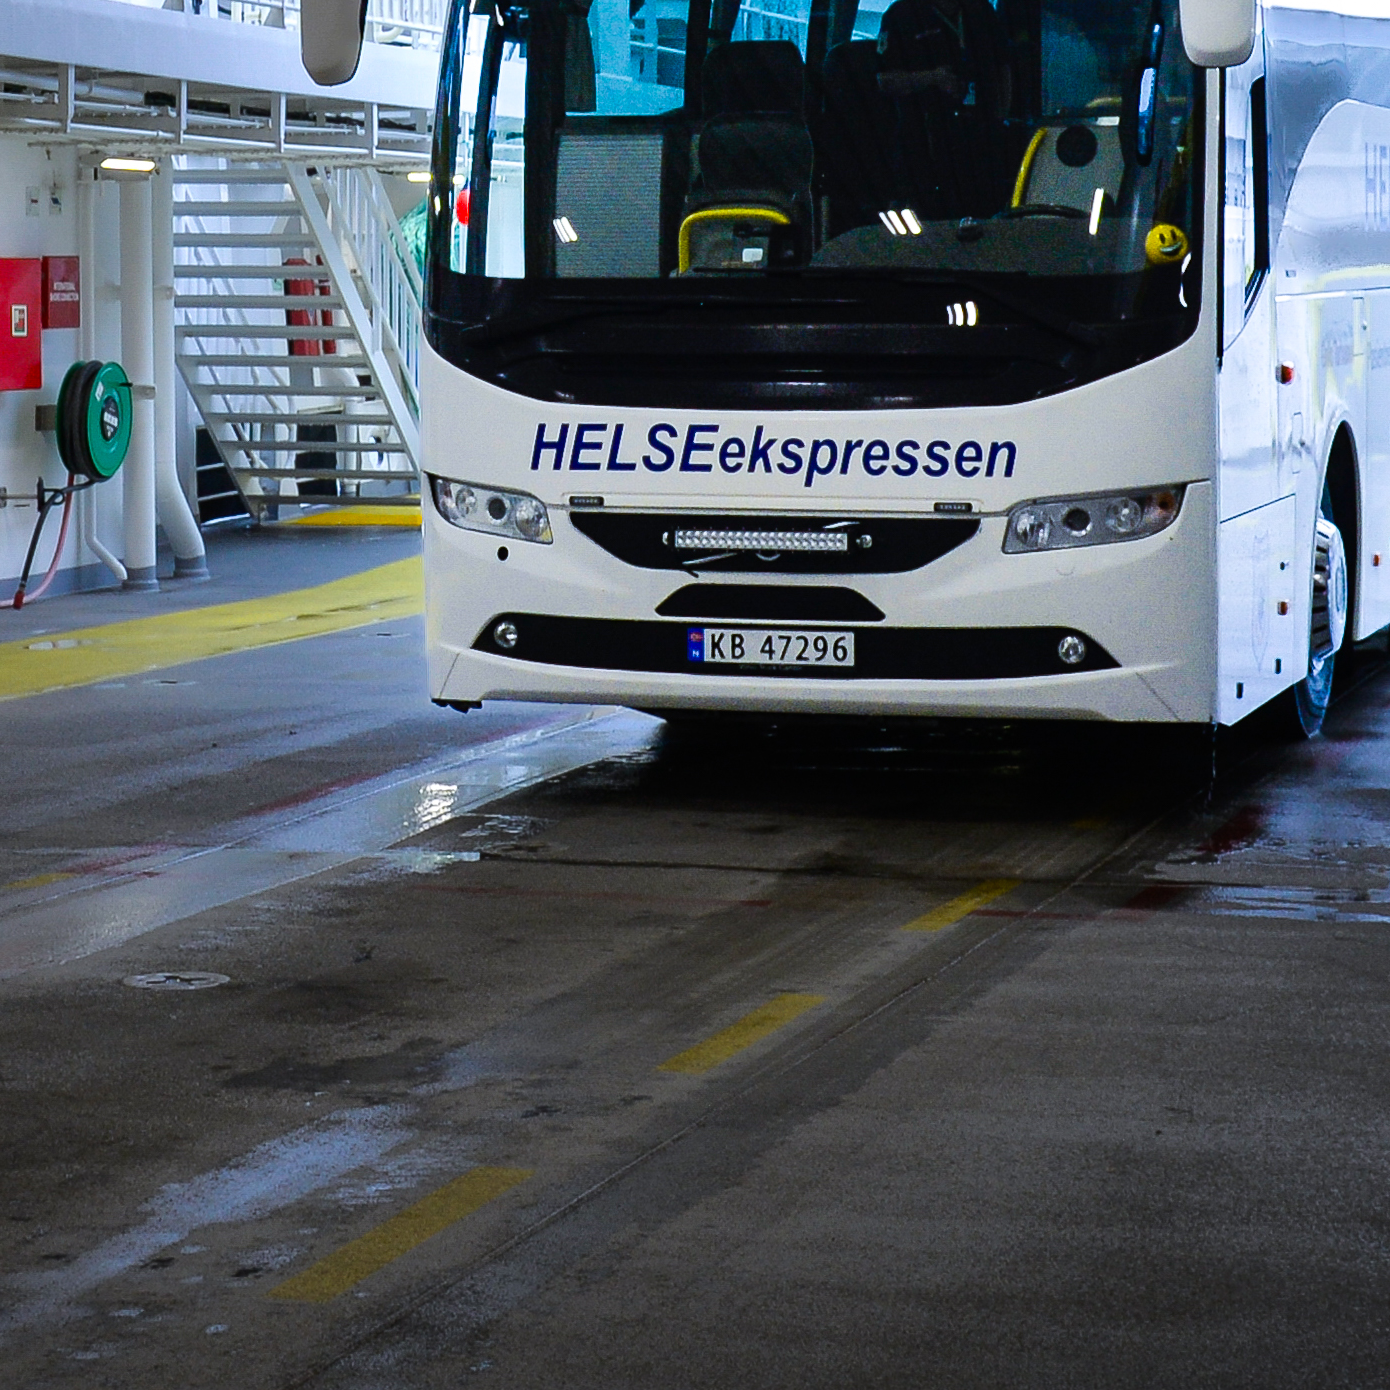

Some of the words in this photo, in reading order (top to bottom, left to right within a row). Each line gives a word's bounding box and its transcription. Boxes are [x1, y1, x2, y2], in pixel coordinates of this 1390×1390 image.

[530, 422, 1017, 488] HELSEekspressen
[710, 632, 746, 660] KB
[760, 634, 849, 662] 47296
